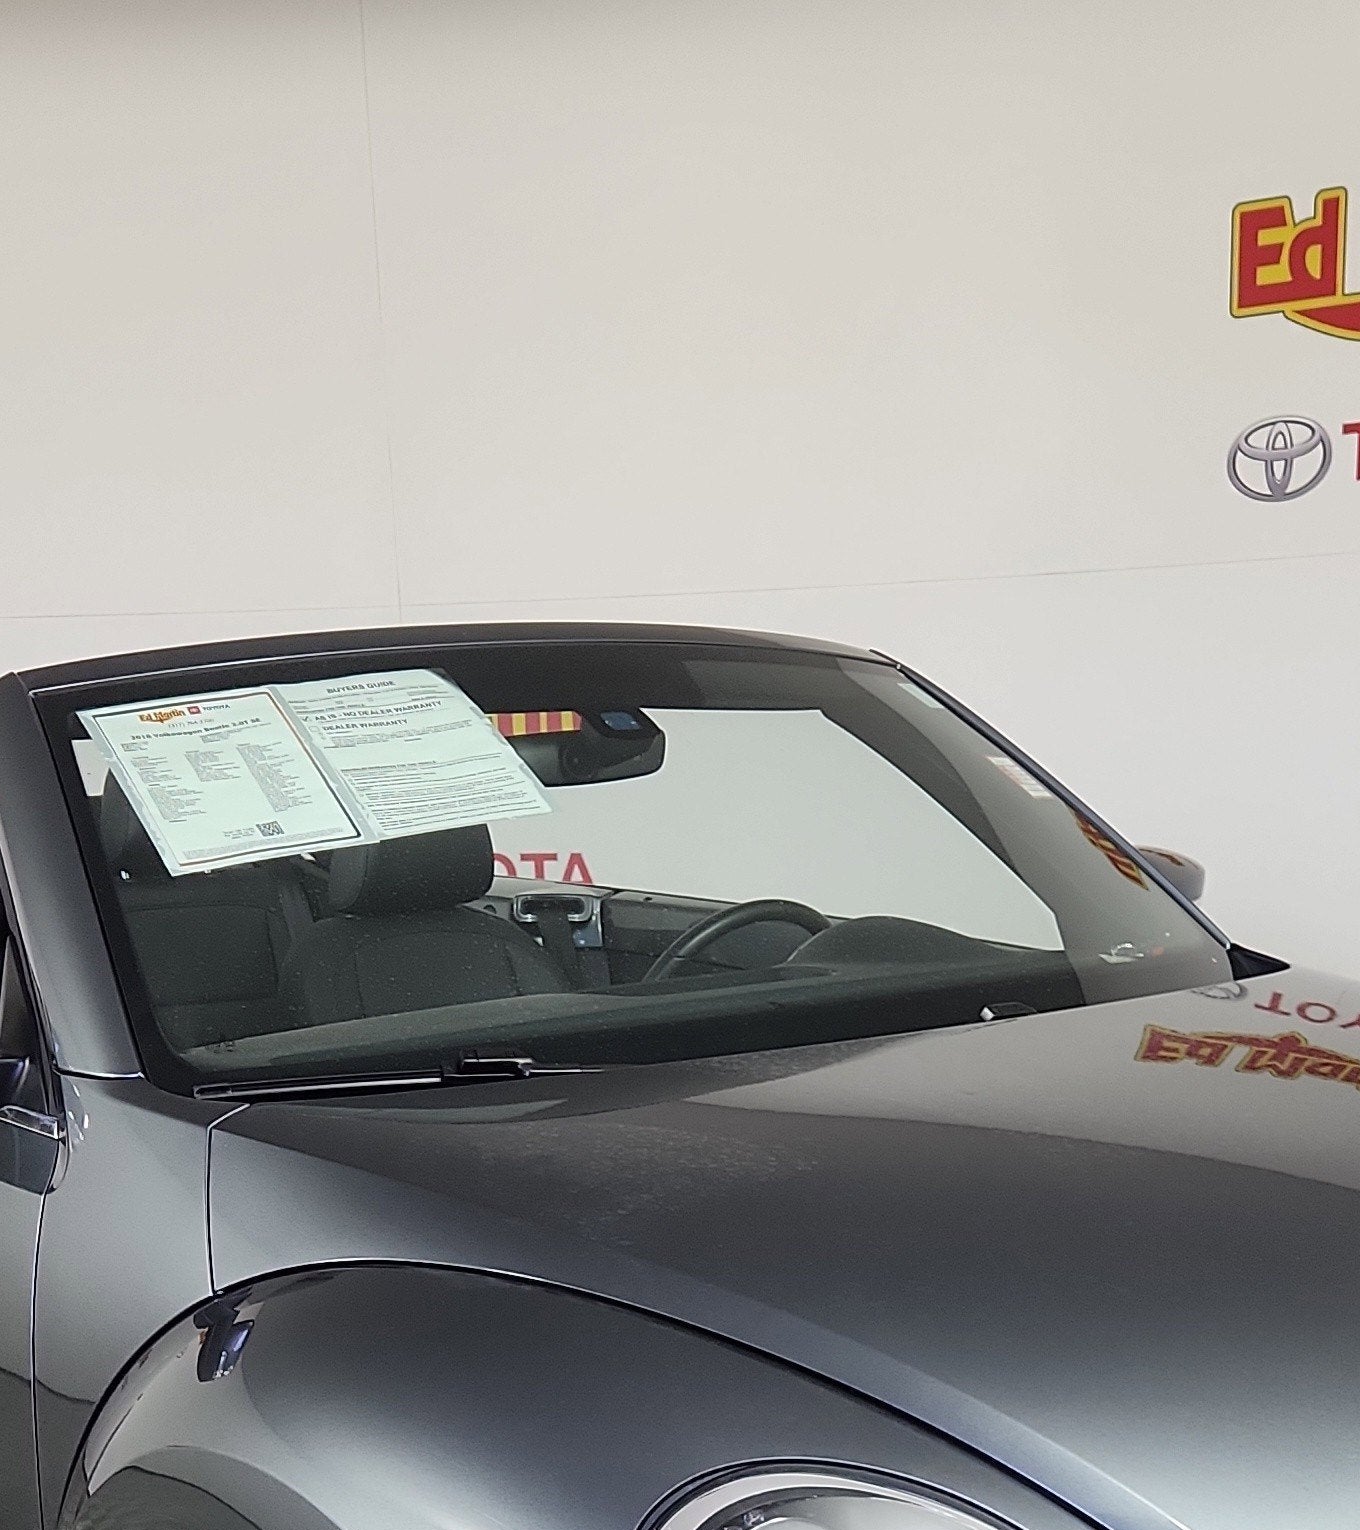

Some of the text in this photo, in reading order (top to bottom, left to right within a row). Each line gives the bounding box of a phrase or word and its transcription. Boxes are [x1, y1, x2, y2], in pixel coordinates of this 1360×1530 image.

[1232, 188, 1346, 316] Ed
[326, 680, 396, 694] BUYERS GUIDE
[358, 708, 392, 717] DEALER
[393, 701, 443, 713] WARRANTY
[322, 718, 409, 731] DEALER WARRANTY
